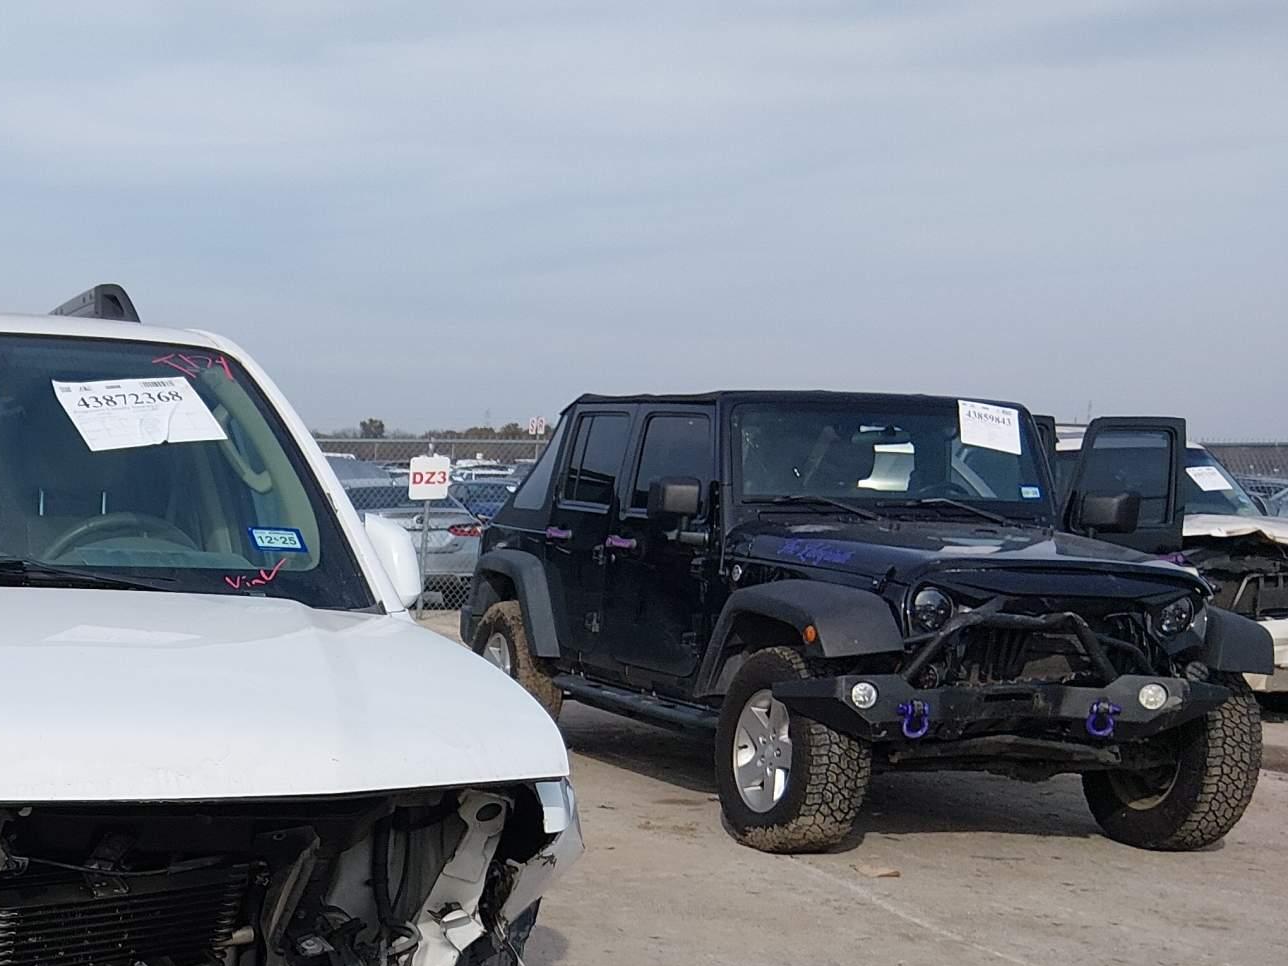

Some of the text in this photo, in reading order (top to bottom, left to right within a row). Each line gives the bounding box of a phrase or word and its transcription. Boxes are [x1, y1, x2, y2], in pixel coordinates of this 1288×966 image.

[77, 390, 184, 409] 43872368
[412, 471, 448, 485] DZ3
[257, 535, 298, 546] 12 25
